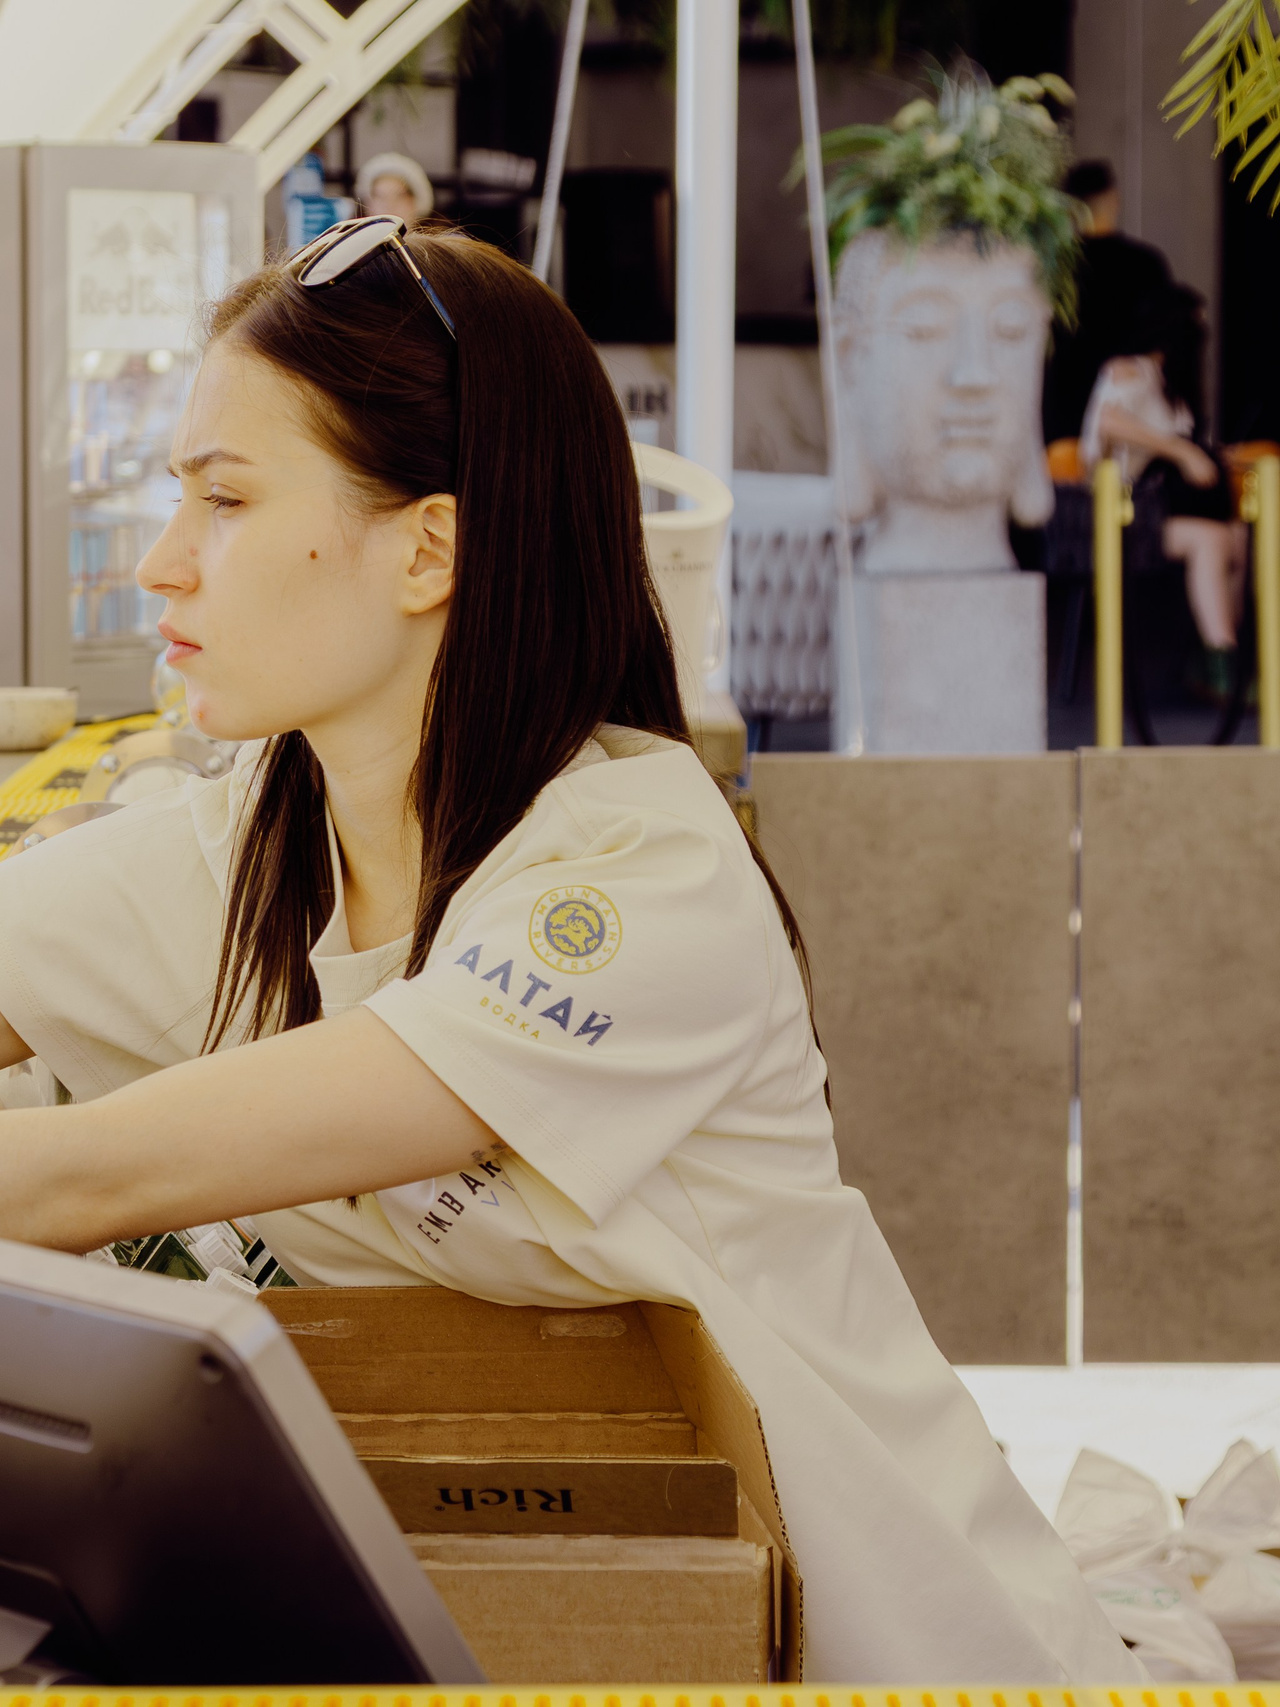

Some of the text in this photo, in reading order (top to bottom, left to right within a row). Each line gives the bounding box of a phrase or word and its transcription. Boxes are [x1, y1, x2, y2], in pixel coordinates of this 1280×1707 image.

[537, 887, 618, 955] MOUNTAINS
[533, 930, 594, 971] RIVERS
[454, 943, 613, 1047] АЛТАЙ
[480, 995, 541, 1039] ВОДКА
[438, 1487, 576, 1514] Rich
